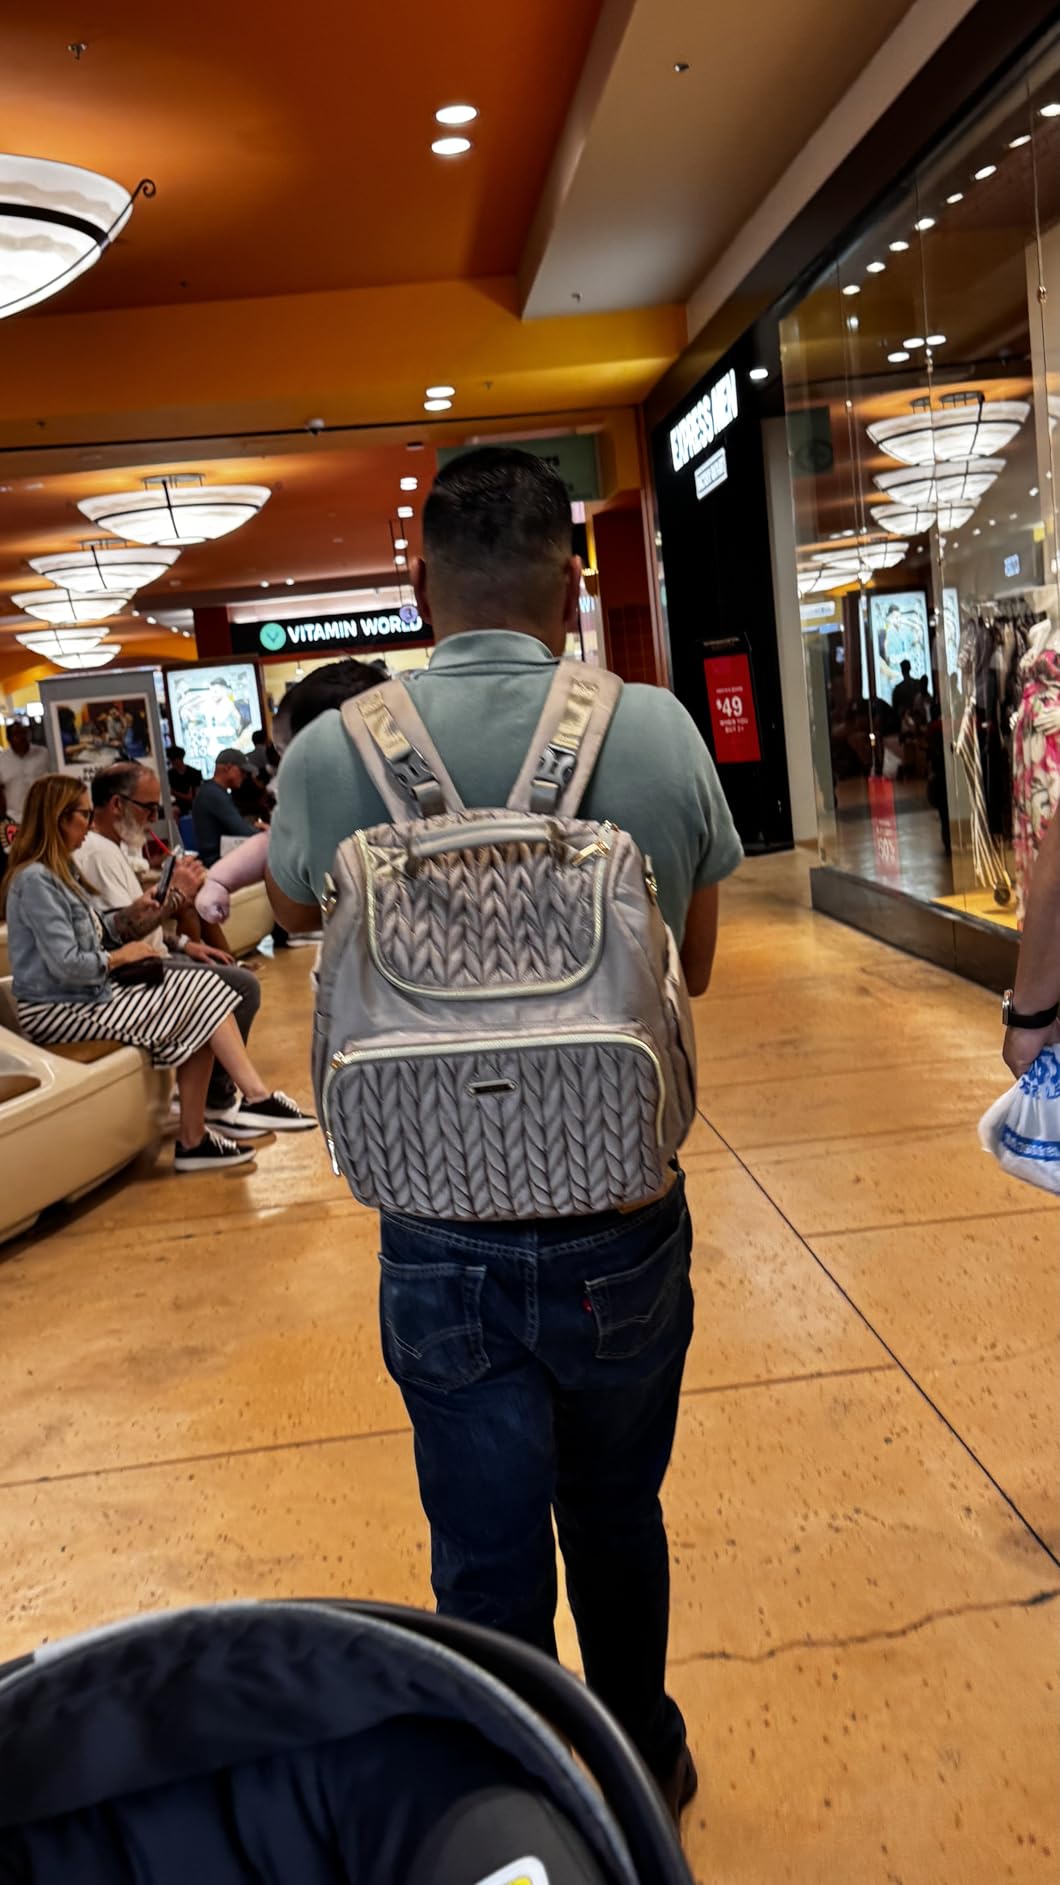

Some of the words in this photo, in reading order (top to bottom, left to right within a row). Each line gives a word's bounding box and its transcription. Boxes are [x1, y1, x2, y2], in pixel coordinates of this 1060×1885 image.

[669, 393, 715, 473] EXPRESS
[710, 367, 739, 436] MEN
[286, 618, 358, 644] VITAMIN
